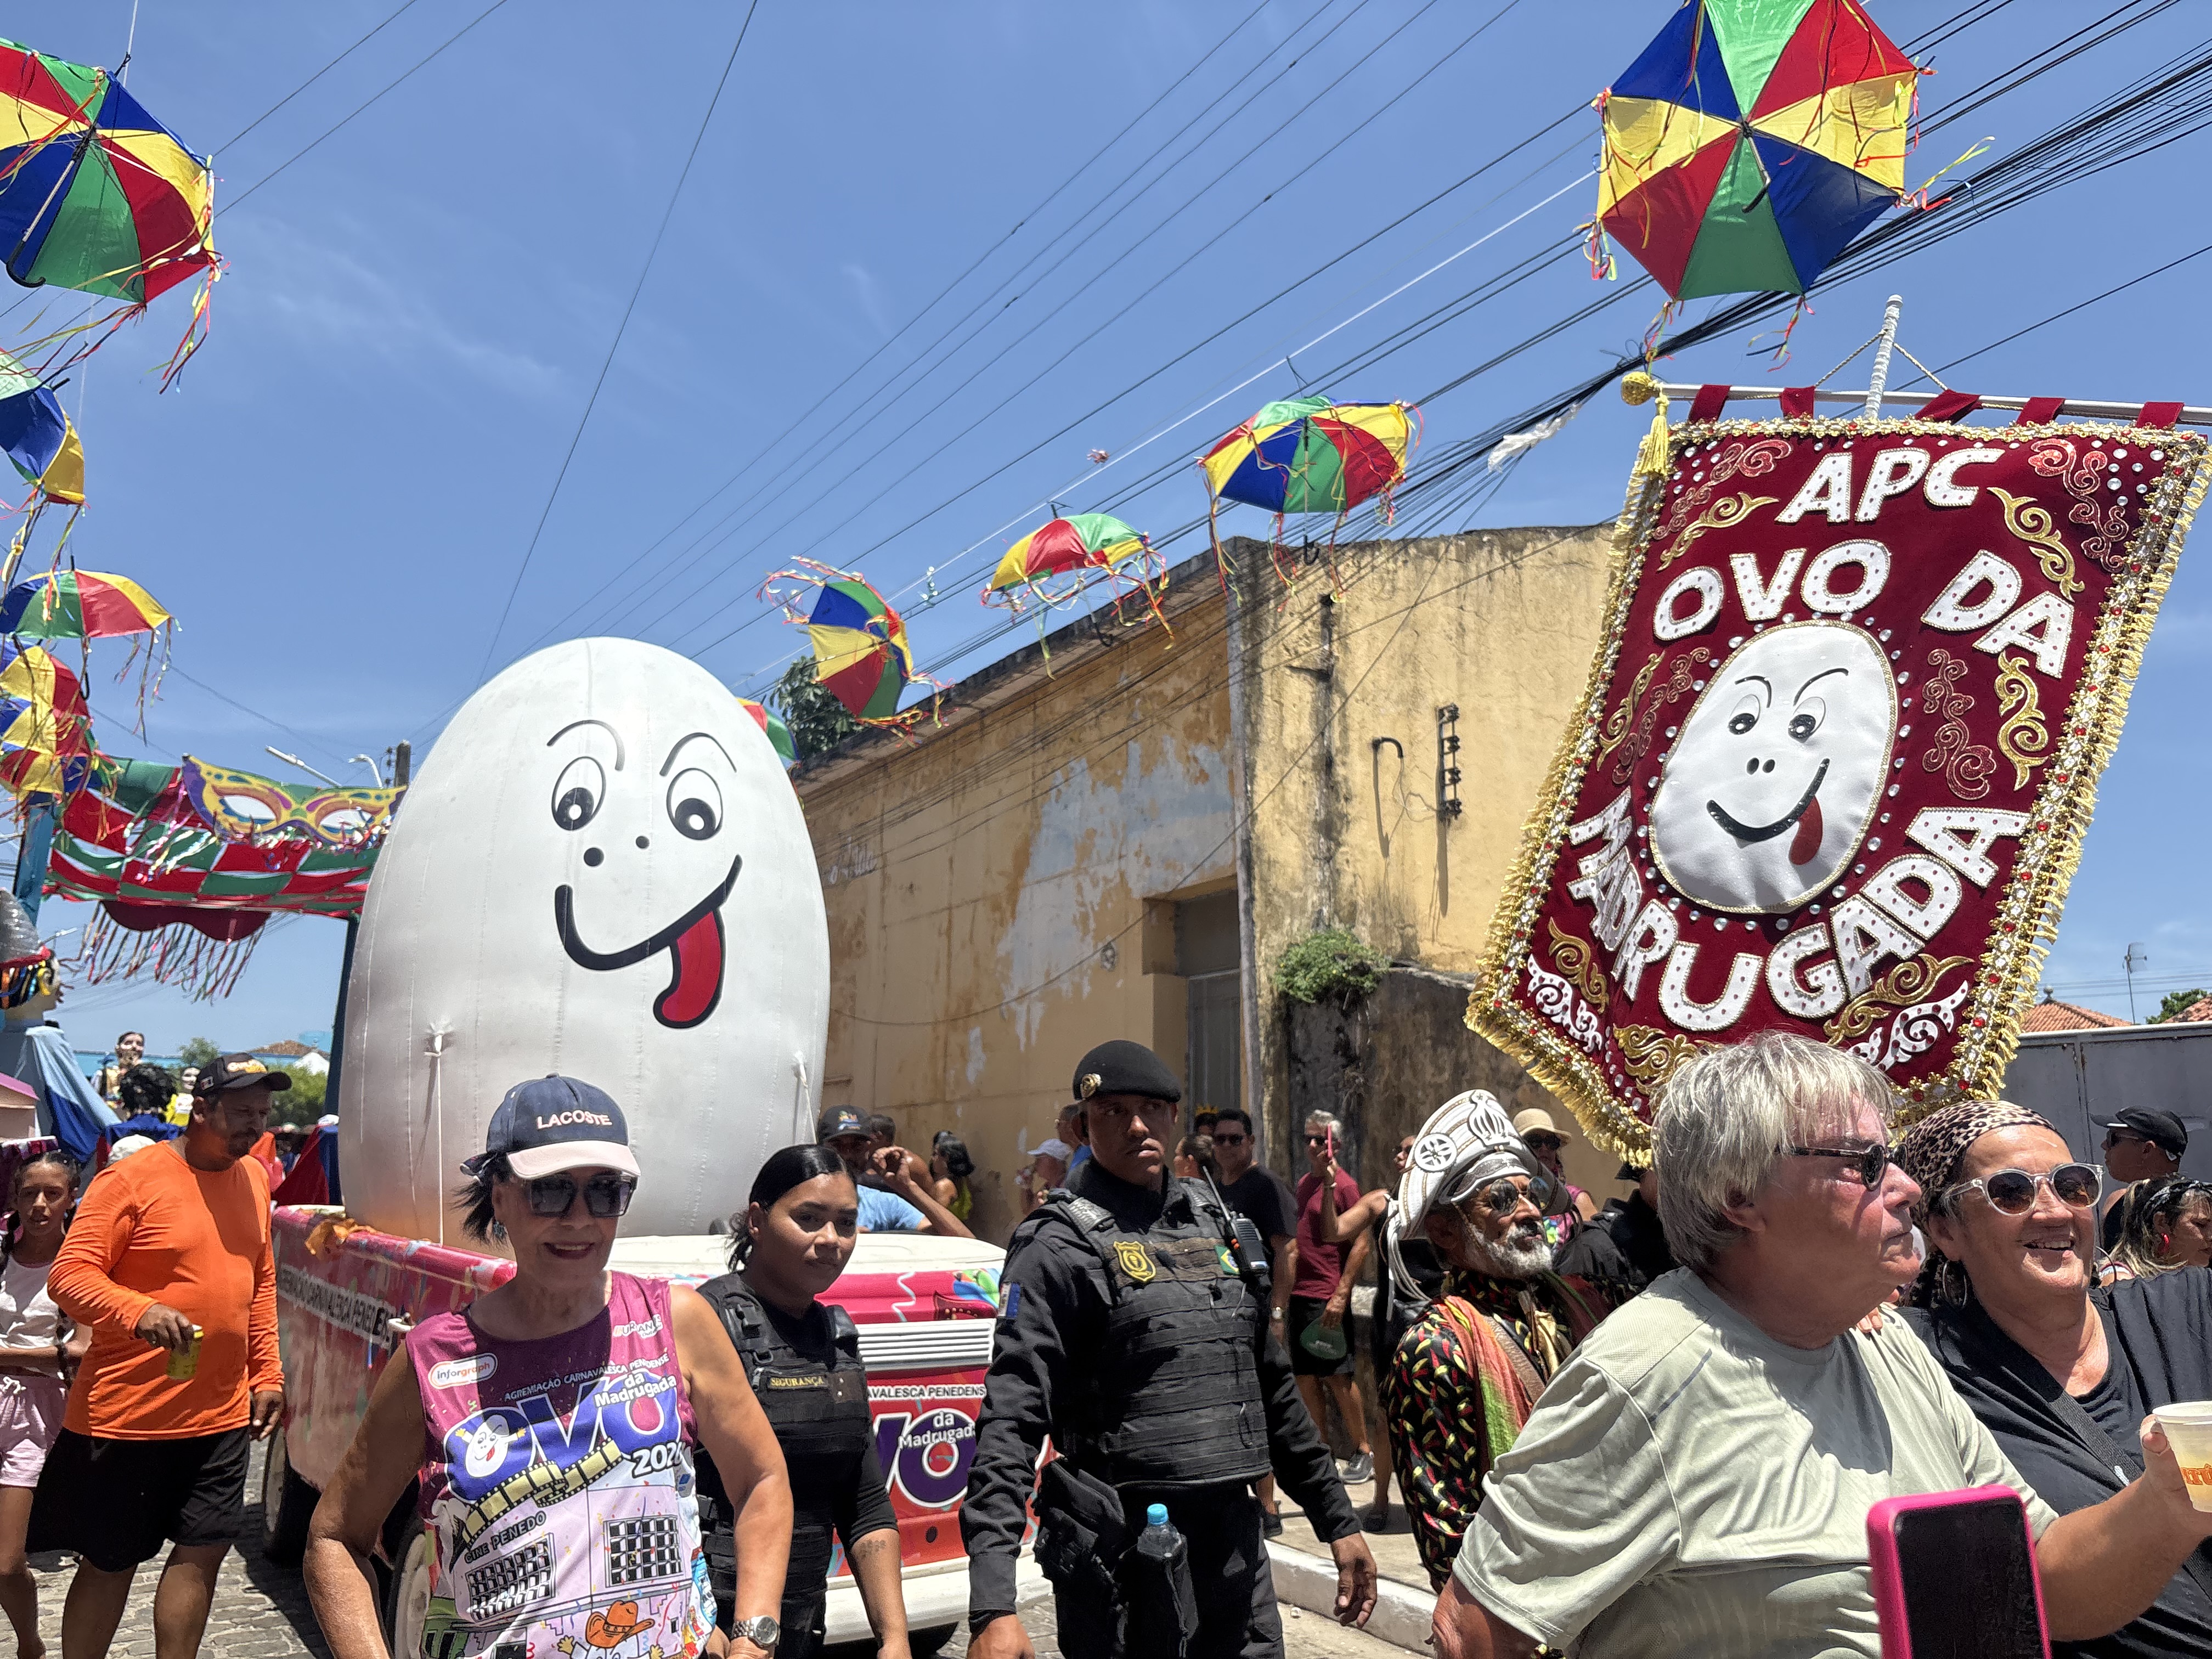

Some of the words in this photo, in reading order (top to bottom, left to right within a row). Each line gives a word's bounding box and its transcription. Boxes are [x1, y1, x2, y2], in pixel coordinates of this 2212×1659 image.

[1775, 448, 2004, 523] APC
[1653, 538, 1892, 641] OVO
[1920, 549, 2075, 679] DA
[1567, 786, 2033, 1031] MADRUGADA
[537, 1109, 613, 1130] LACOSTE
[437, 1362, 490, 1380] inforgraph
[504, 1378, 561, 1401] AGREMIAÇÃO
[563, 1364, 628, 1384] CARNAVALESCA
[624, 1372, 645, 1388] da
[770, 1376, 825, 1387] SEGURANÇA
[594, 1375, 677, 1407] Madrugada
[933, 1410, 955, 1427] da
[443, 1368, 681, 1504] OVO
[465, 1542, 490, 1564] CINE
[491, 1510, 546, 1550] PENEDO
